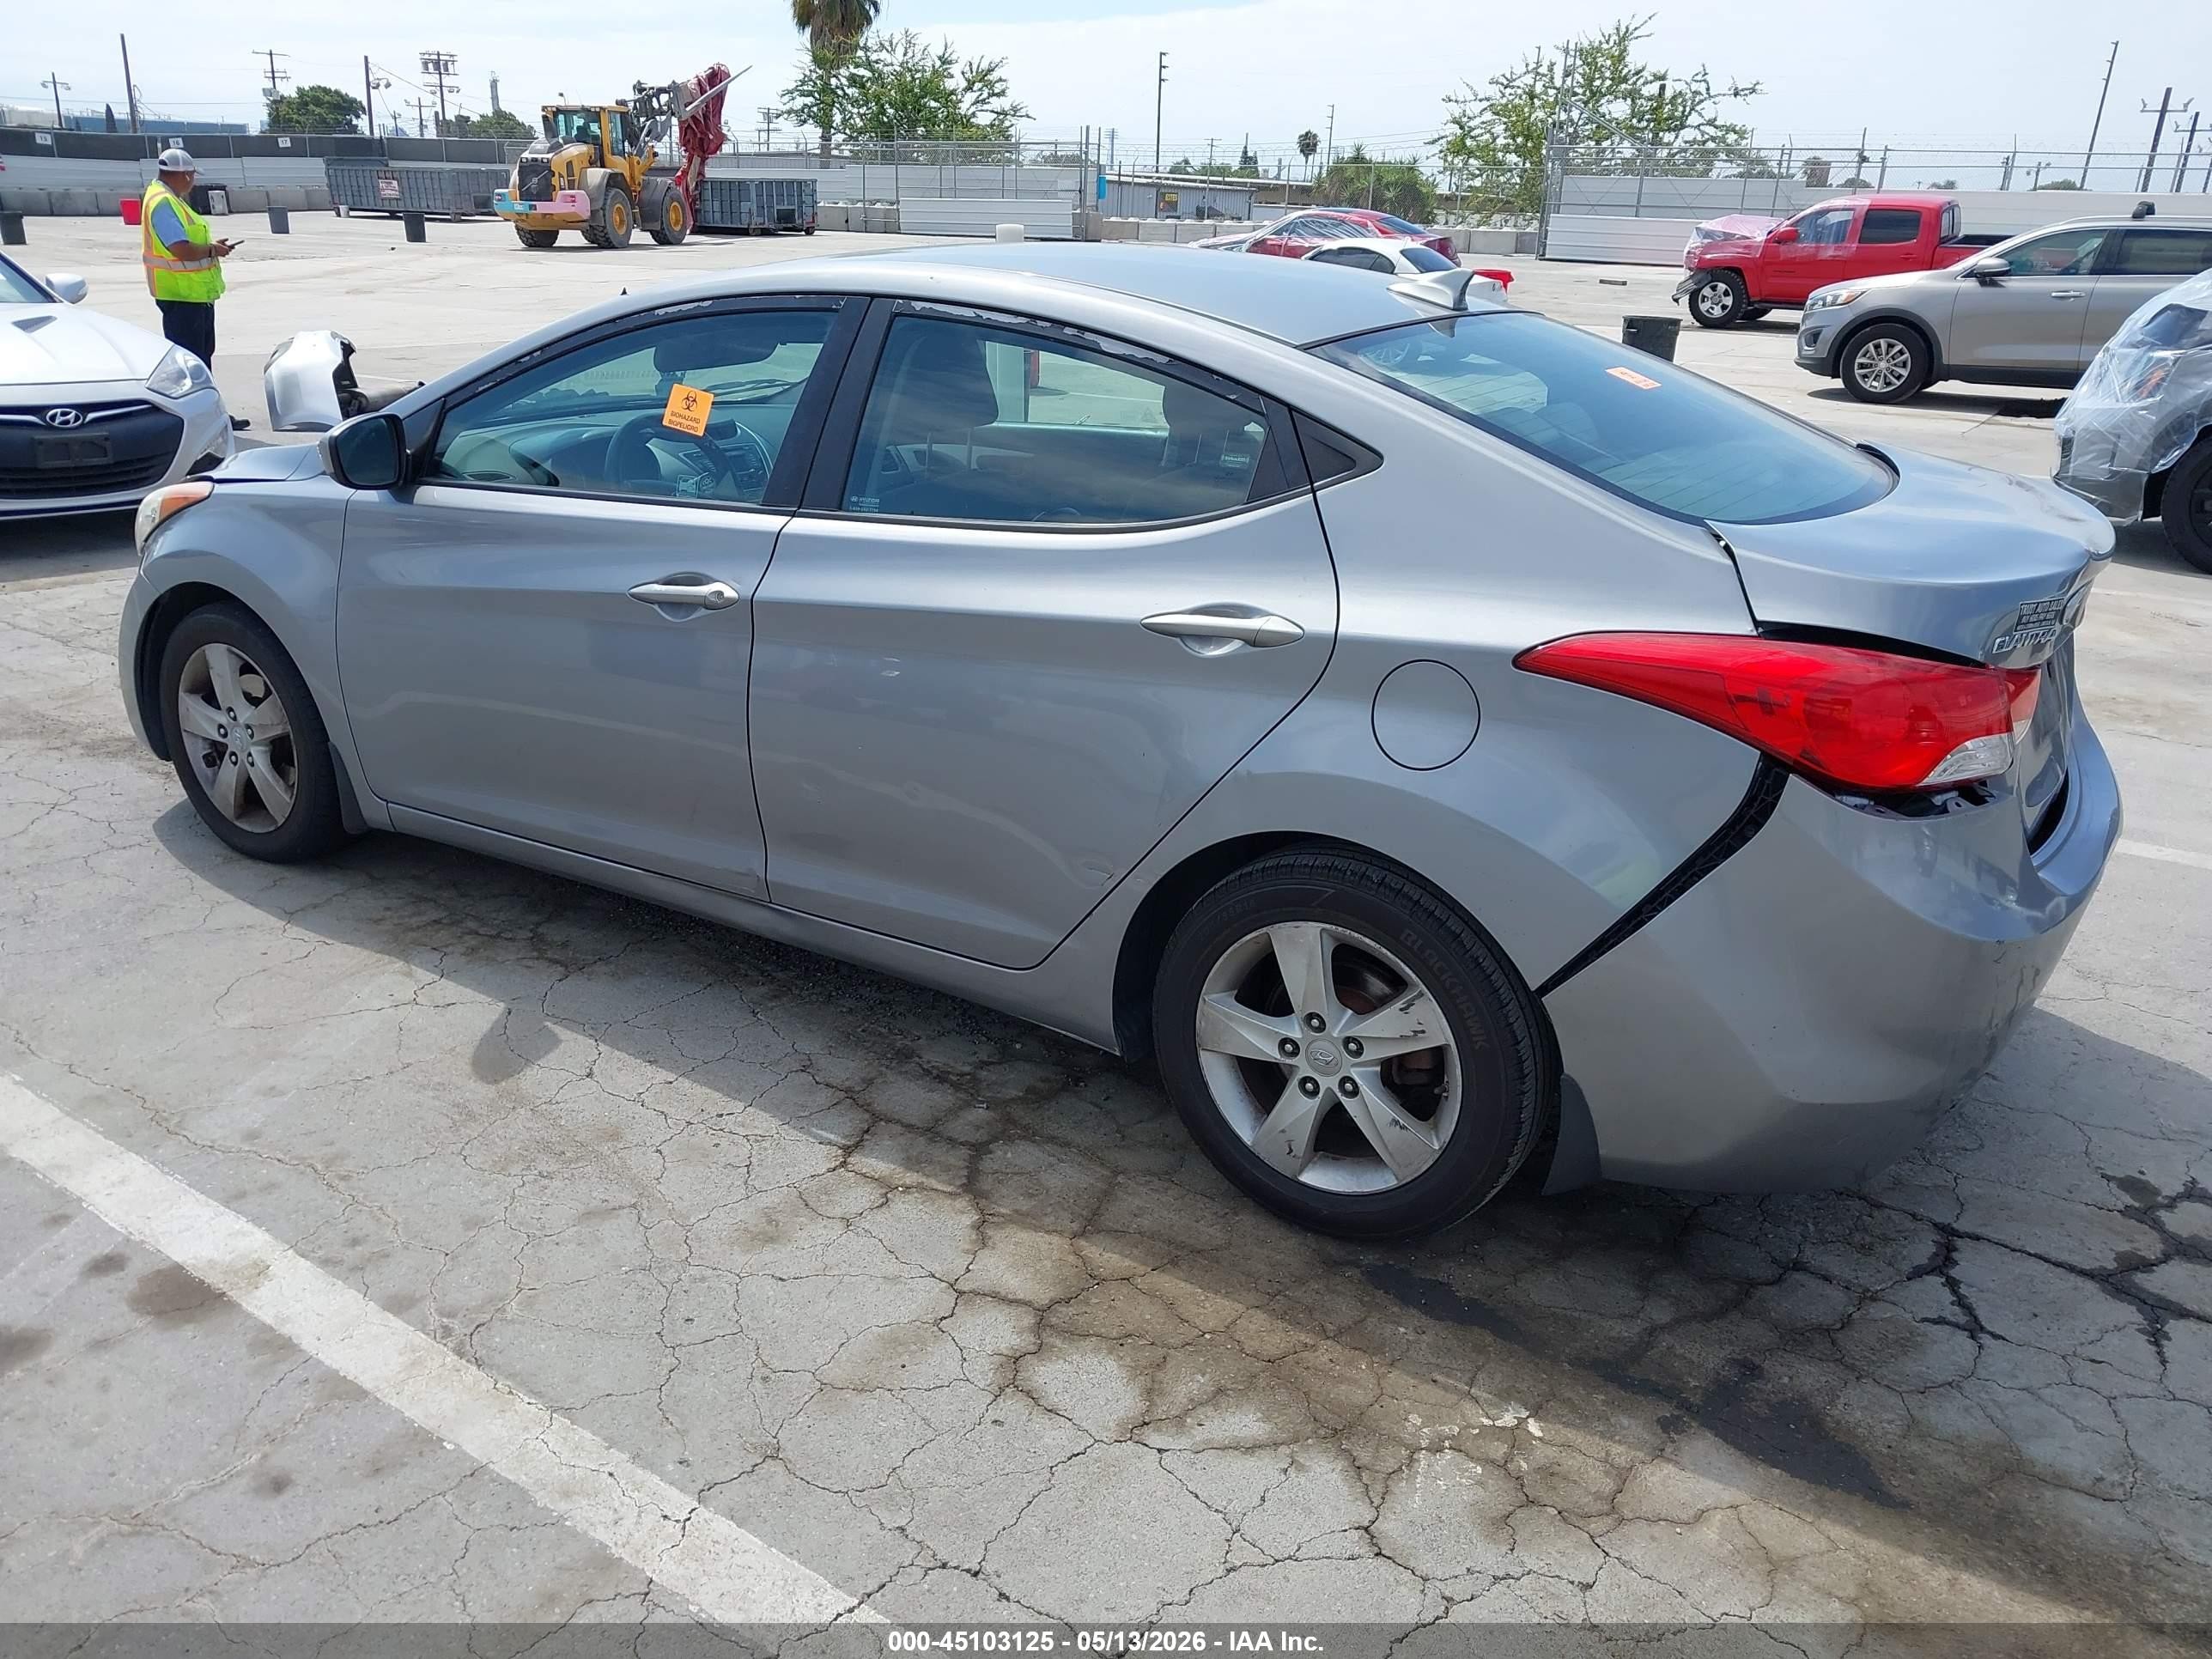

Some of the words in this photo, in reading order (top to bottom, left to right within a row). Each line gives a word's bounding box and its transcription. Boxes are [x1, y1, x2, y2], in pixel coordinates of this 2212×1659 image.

[670, 410, 700, 423] BIOHAZARD
[1992, 629, 2057, 653] ELANTRA
[1400, 928, 1490, 1050] BLACKHAWK
